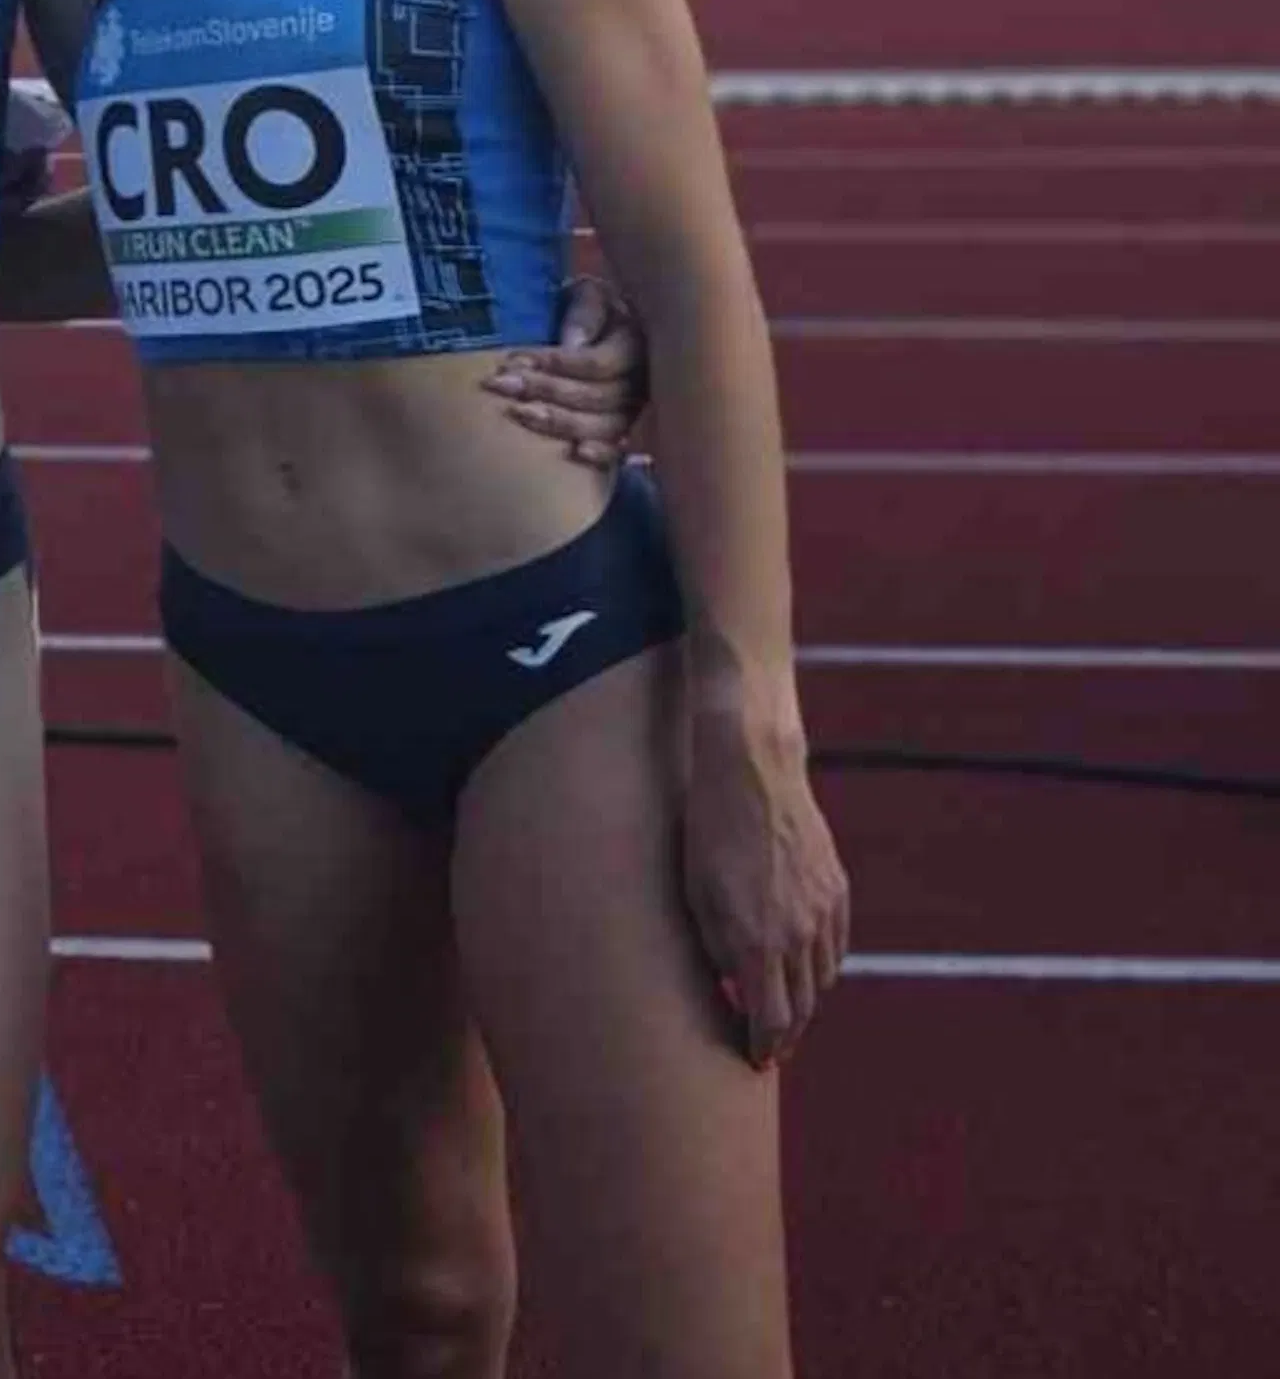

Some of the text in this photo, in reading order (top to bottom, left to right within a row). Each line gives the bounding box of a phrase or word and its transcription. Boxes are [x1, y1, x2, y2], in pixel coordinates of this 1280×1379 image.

[95, 83, 348, 221] CRO
[131, 230, 187, 260] RUN
[189, 221, 296, 257] CLEAN
[123, 260, 386, 318] ARIBOR 2025
